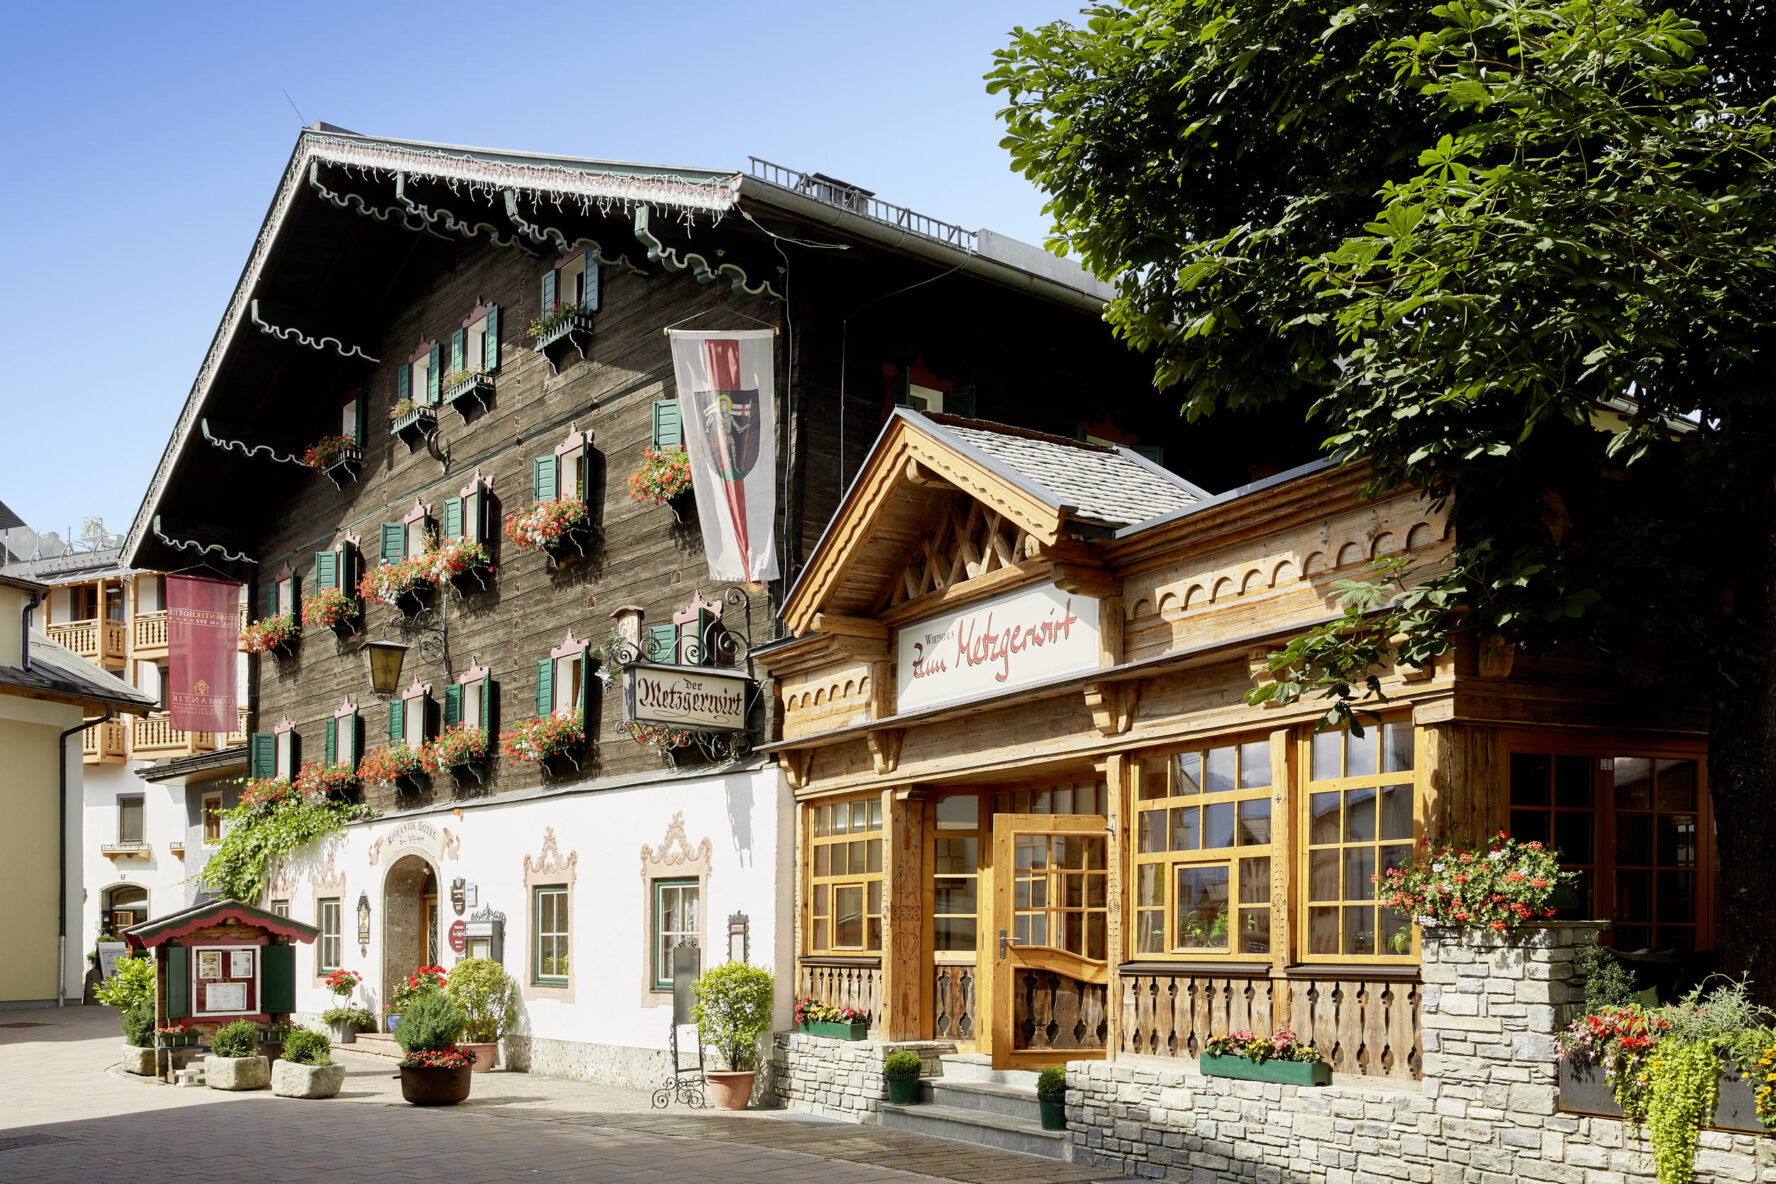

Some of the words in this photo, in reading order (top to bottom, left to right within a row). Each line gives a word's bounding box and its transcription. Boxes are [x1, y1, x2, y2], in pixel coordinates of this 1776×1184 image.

[912, 642, 947, 679] Zum
[955, 597, 1078, 682] Metzgerwirt
[638, 678, 742, 716] Metzgerwirt
[417, 820, 438, 841] HOTEL
